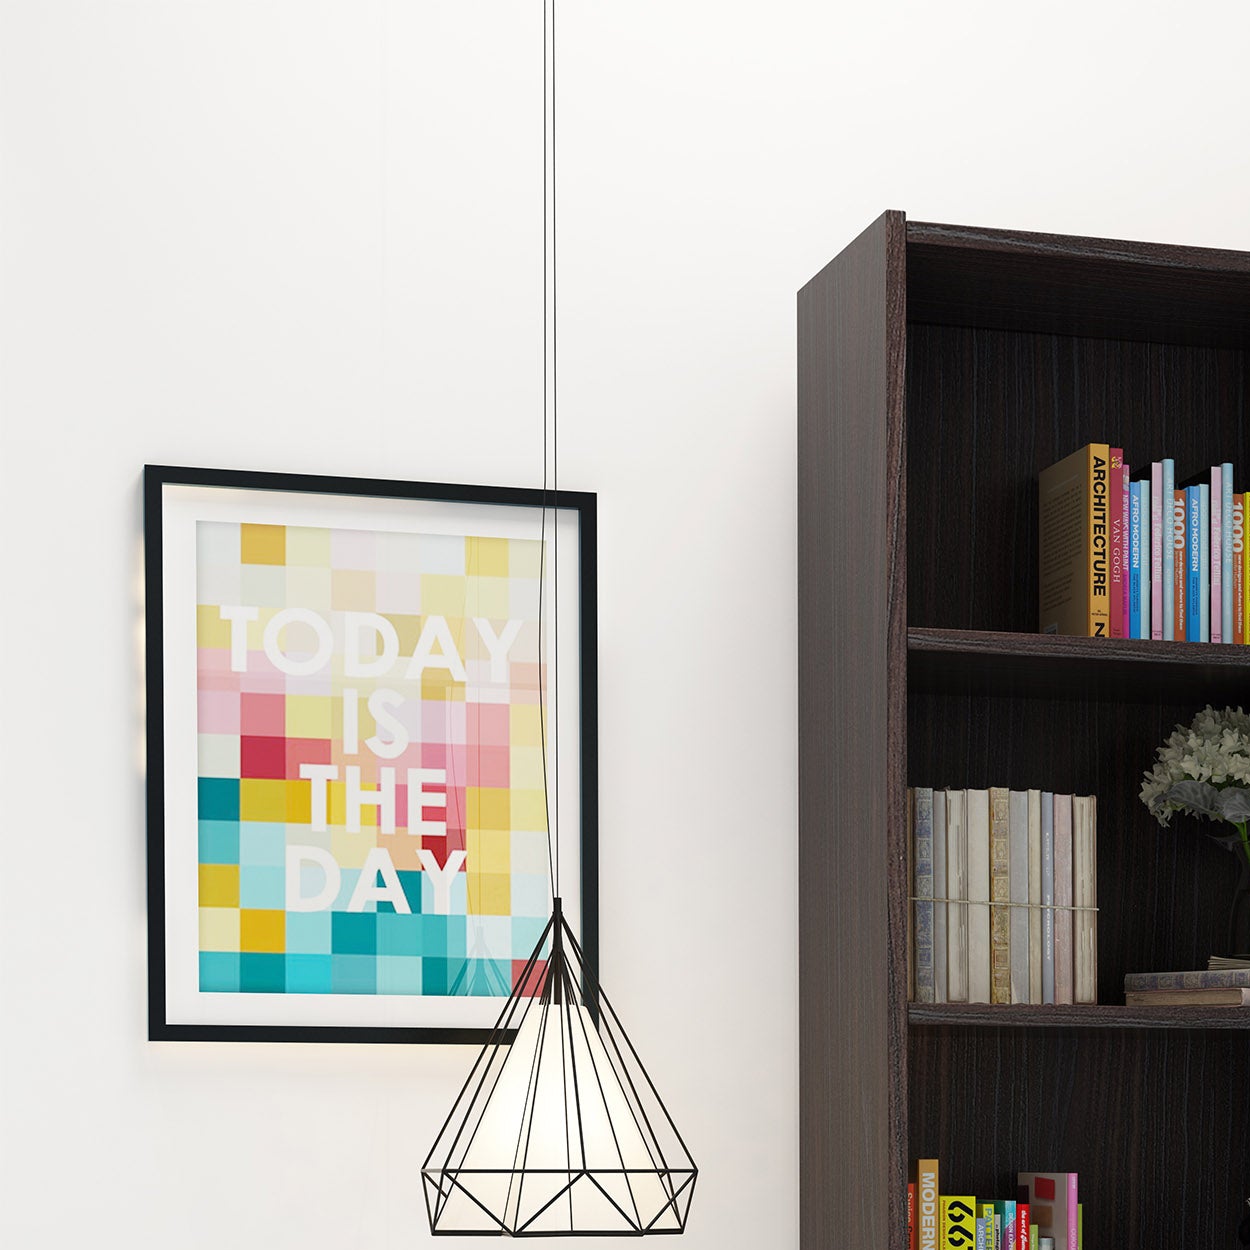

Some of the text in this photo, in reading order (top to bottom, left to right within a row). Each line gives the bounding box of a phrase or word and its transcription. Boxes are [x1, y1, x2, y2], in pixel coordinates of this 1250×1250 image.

[1094, 456, 1106, 597] ARCHITECTURE
[1174, 498, 1184, 549] 1000
[1233, 502, 1243, 552] 1000
[220, 605, 523, 683] TODAY
[343, 688, 408, 758] IS
[300, 763, 446, 836] THE
[285, 845, 467, 914] DAY
